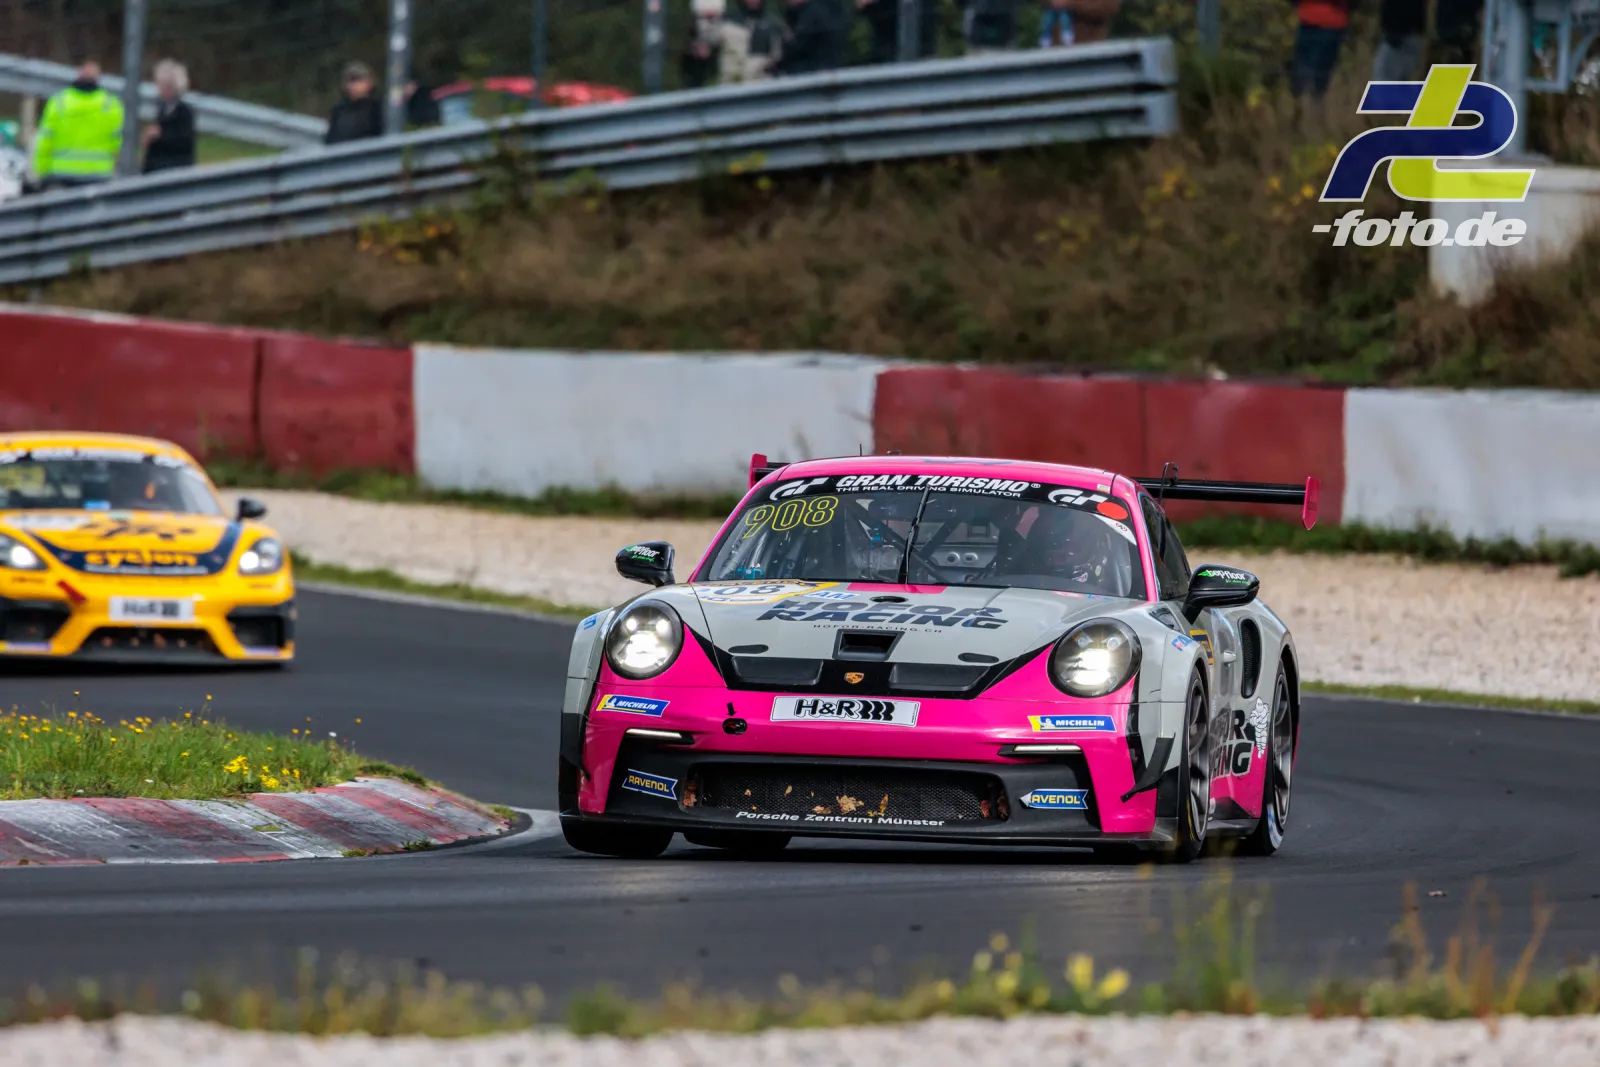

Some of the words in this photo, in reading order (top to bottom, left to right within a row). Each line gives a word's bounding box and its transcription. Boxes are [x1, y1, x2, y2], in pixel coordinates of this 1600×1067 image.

[836, 474, 911, 487] GRAN
[914, 475, 1029, 492] TURISMO
[950, 487, 1021, 497] SIMULATOR
[742, 496, 839, 539] 908
[772, 600, 1003, 618] HOFOR
[756, 610, 1008, 630] RACING
[616, 701, 659, 711] MICHELIN
[795, 699, 859, 718] H&R
[1055, 719, 1105, 727] MICHELIN
[628, 775, 670, 793] RAVENOL
[1030, 794, 1081, 805] AVENOL
[736, 811, 800, 822] Porsche
[804, 814, 873, 825] Zentrum
[877, 817, 945, 827] Münster
